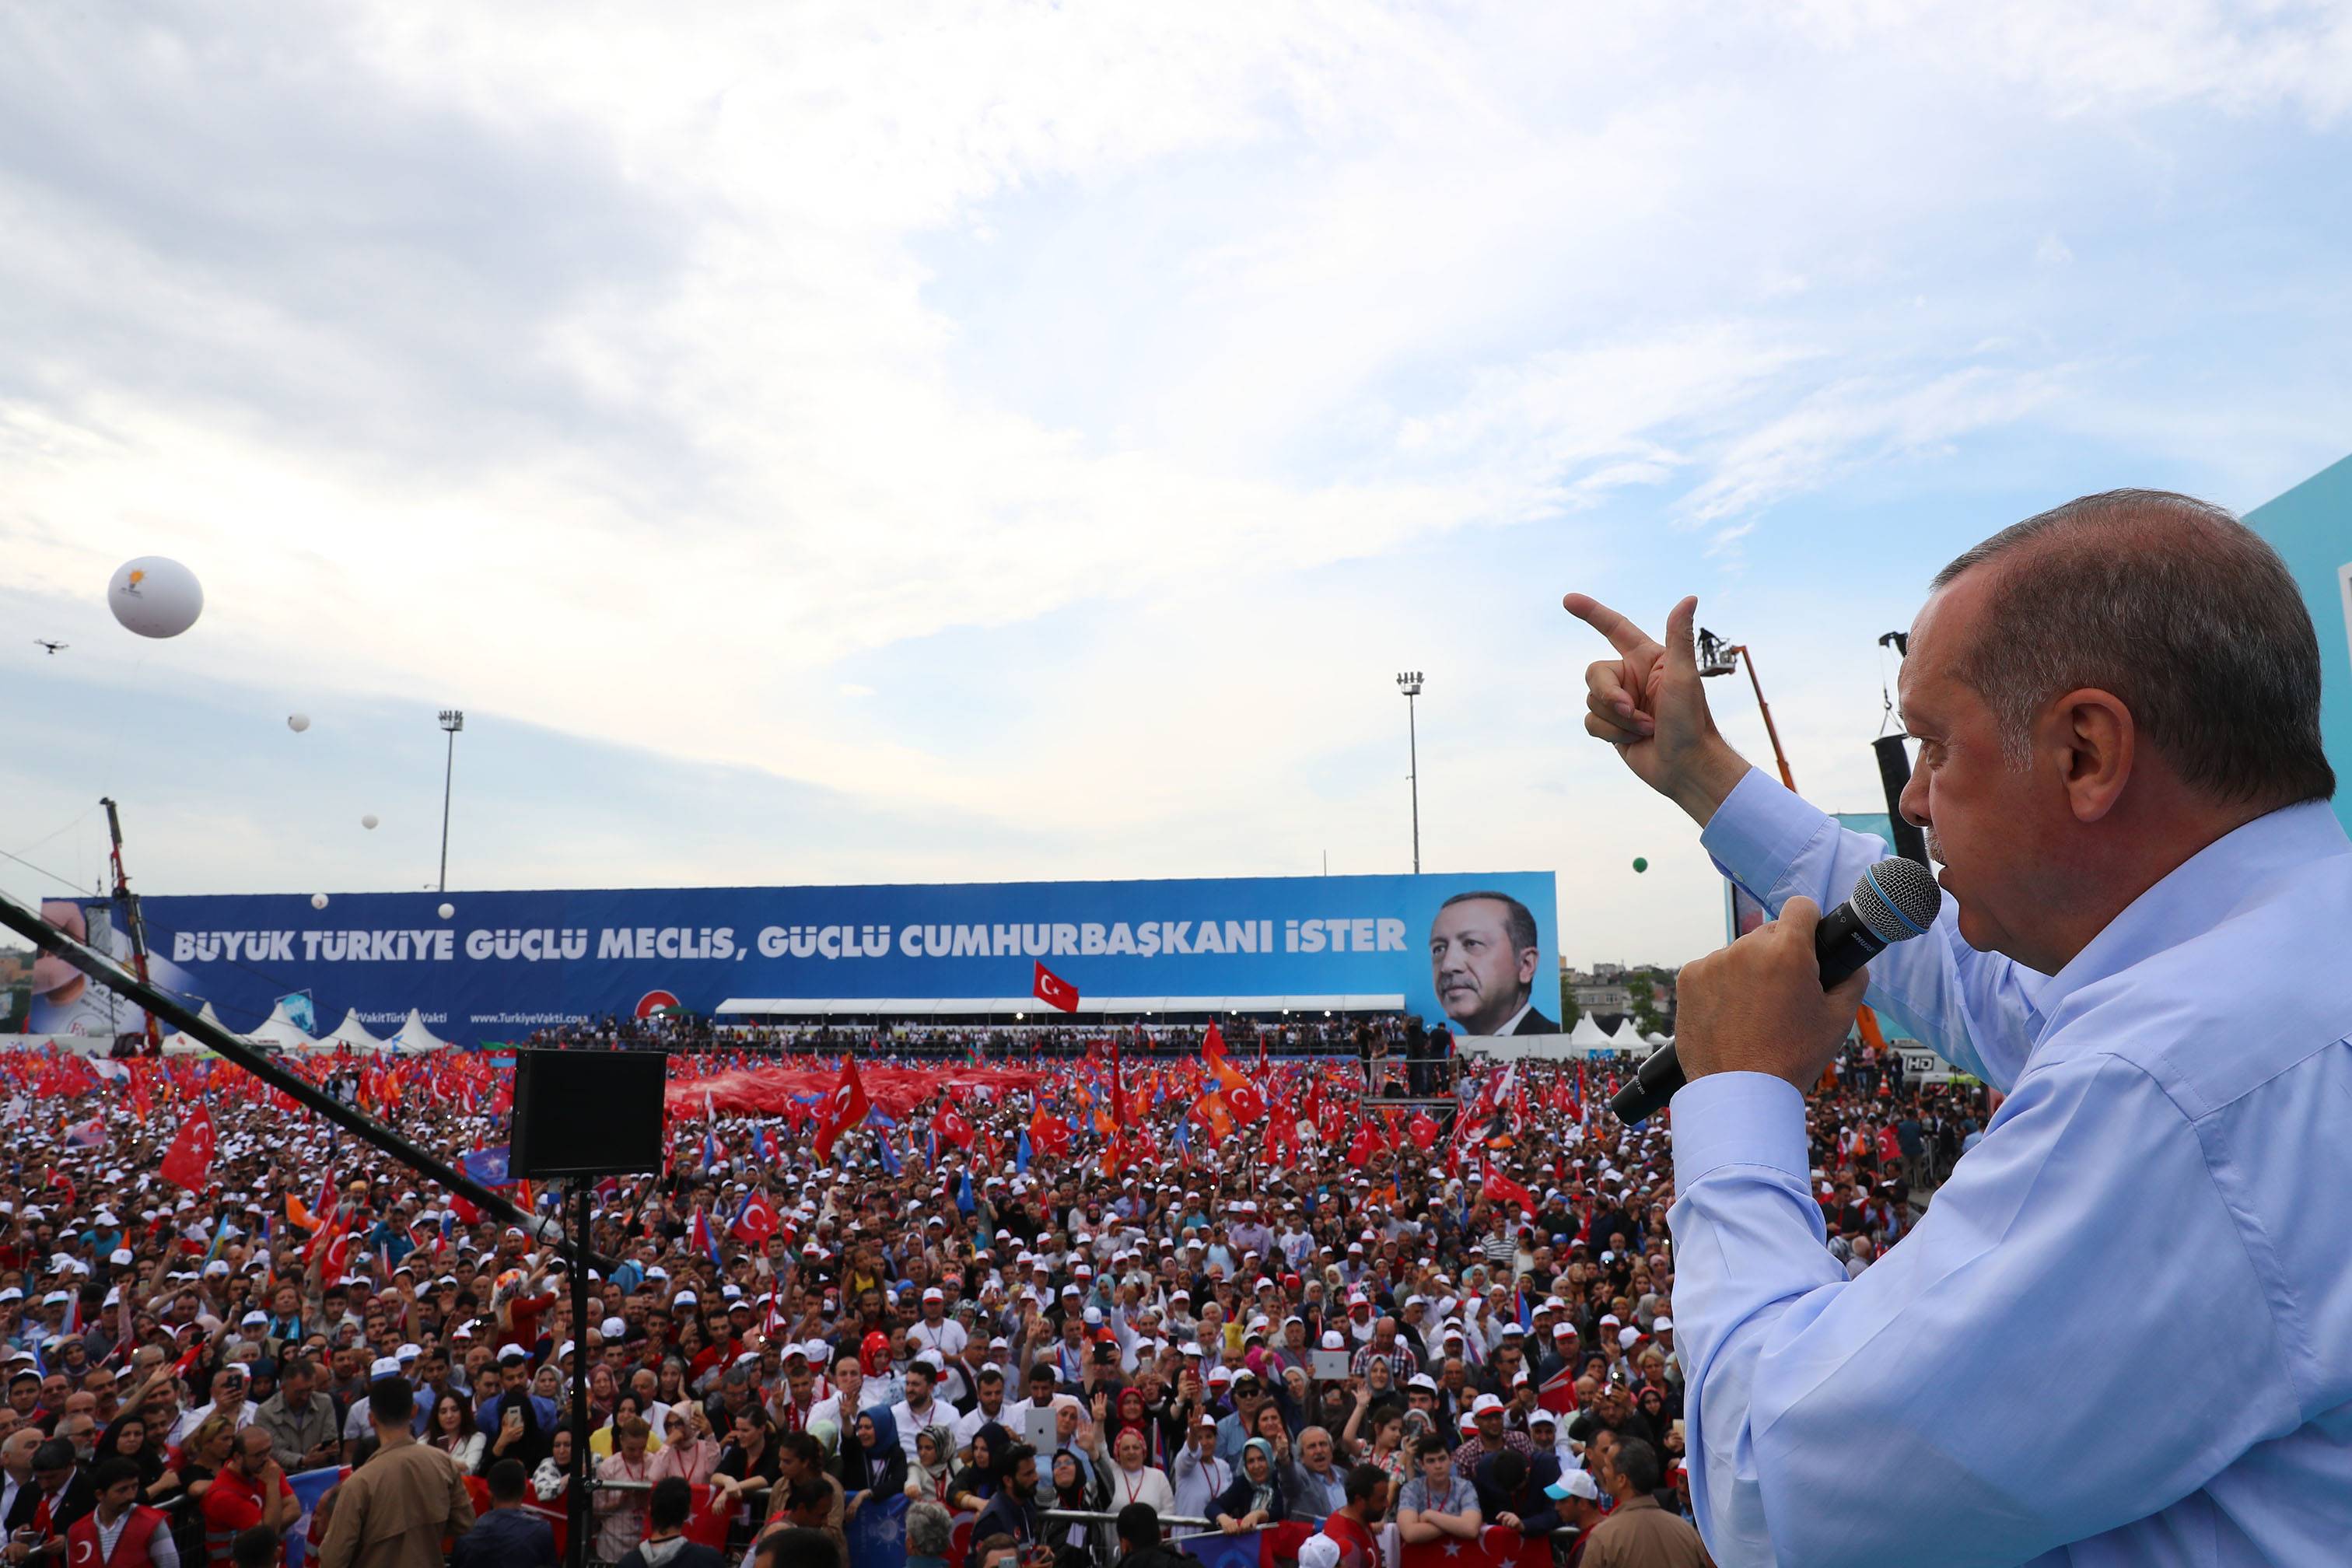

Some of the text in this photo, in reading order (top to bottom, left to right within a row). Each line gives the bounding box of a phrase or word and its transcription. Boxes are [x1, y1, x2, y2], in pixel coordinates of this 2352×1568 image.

[173, 931, 296, 962] BÜYÜK
[466, 929, 587, 961] GÜÇLÜ
[758, 926, 891, 959] GÜÇLÜ
[900, 920, 1272, 958] CUMHURBAŞKANI
[1851, 932, 1874, 951] SHURE
[357, 1012, 447, 1024] VakitTürkVakti
[1907, 1057, 1933, 1070] HD
